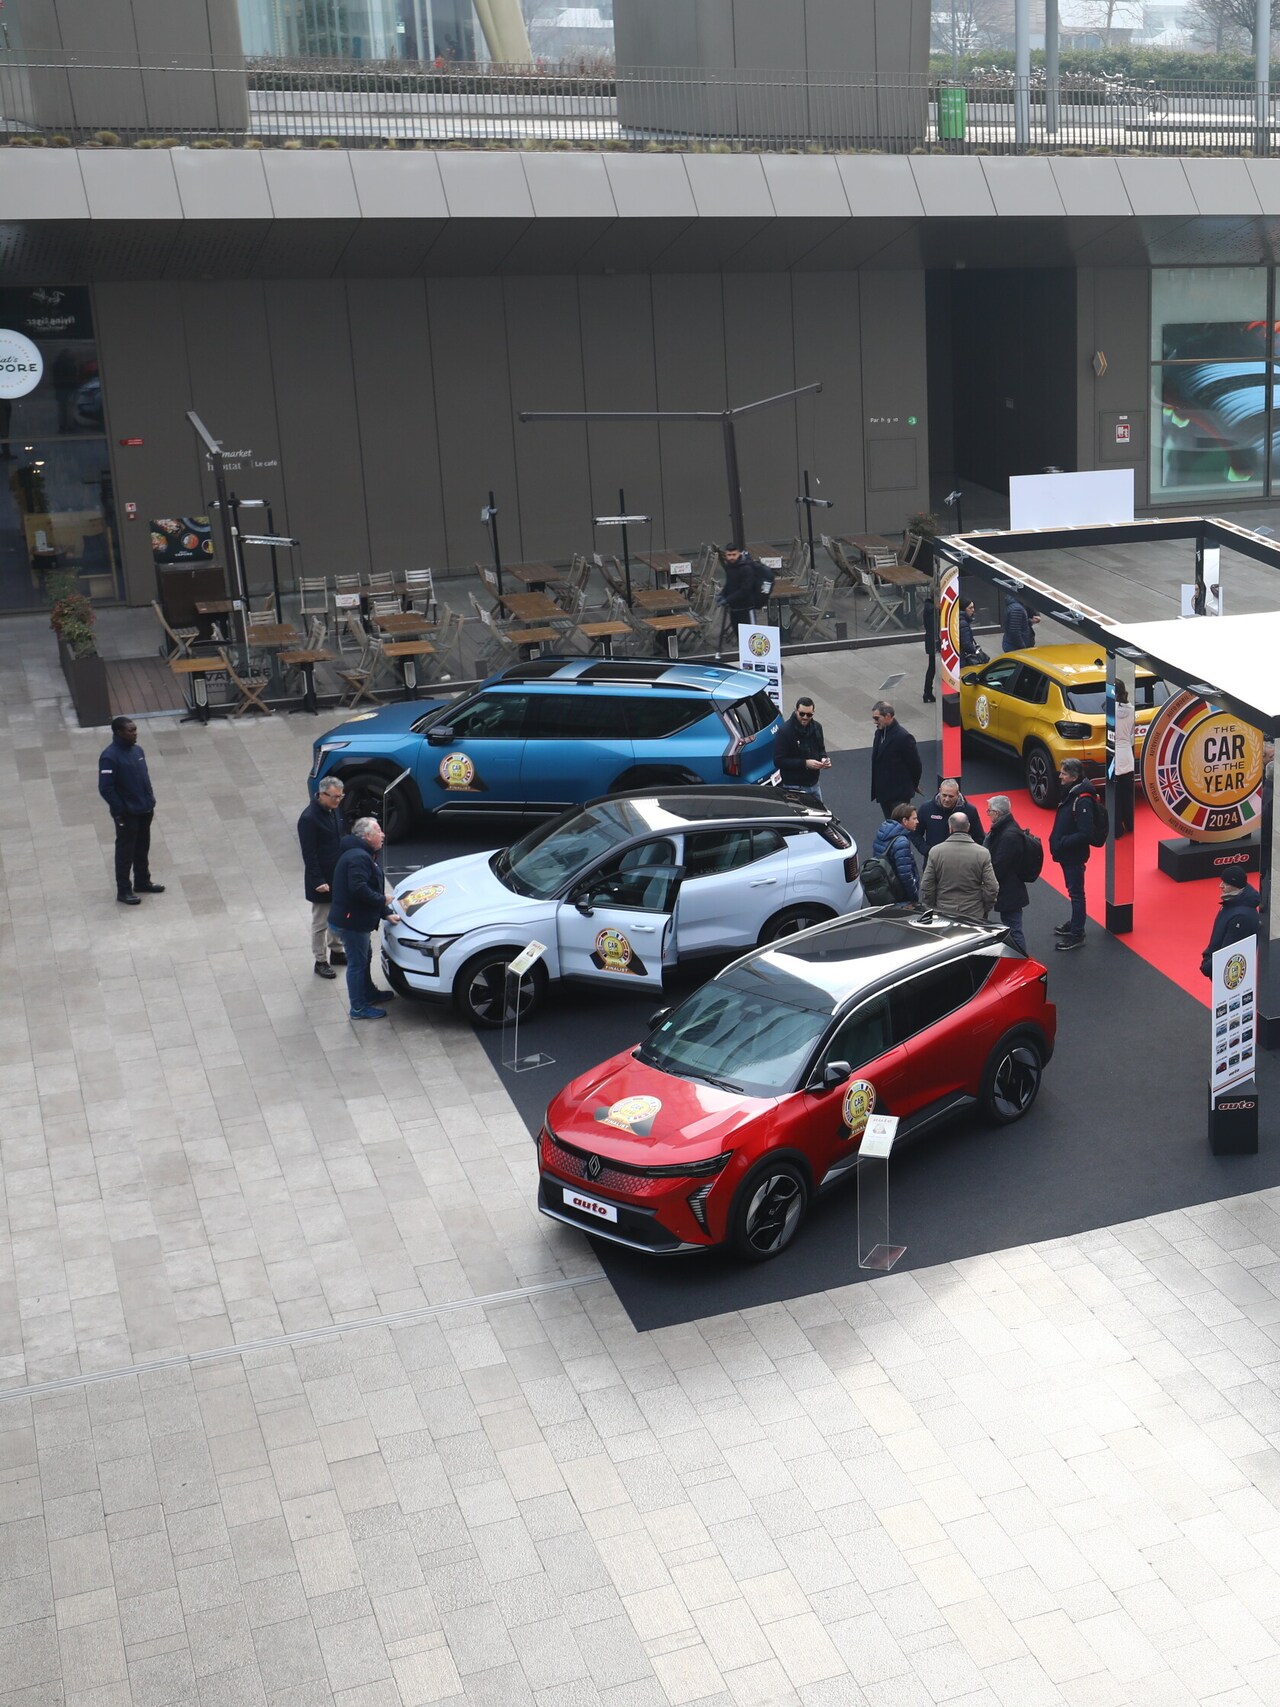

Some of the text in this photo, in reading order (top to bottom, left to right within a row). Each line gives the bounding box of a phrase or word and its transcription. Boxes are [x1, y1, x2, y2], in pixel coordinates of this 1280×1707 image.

[1214, 725, 1236, 734] THE
[1204, 734, 1245, 762] CAR
[1204, 762, 1245, 774] OF THE
[1204, 772, 1244, 794] YEAR
[1209, 812, 1238, 827] 2024
[1214, 852, 1250, 866] auto
[1218, 1100, 1255, 1110] auto
[572, 1198, 607, 1215] auto
